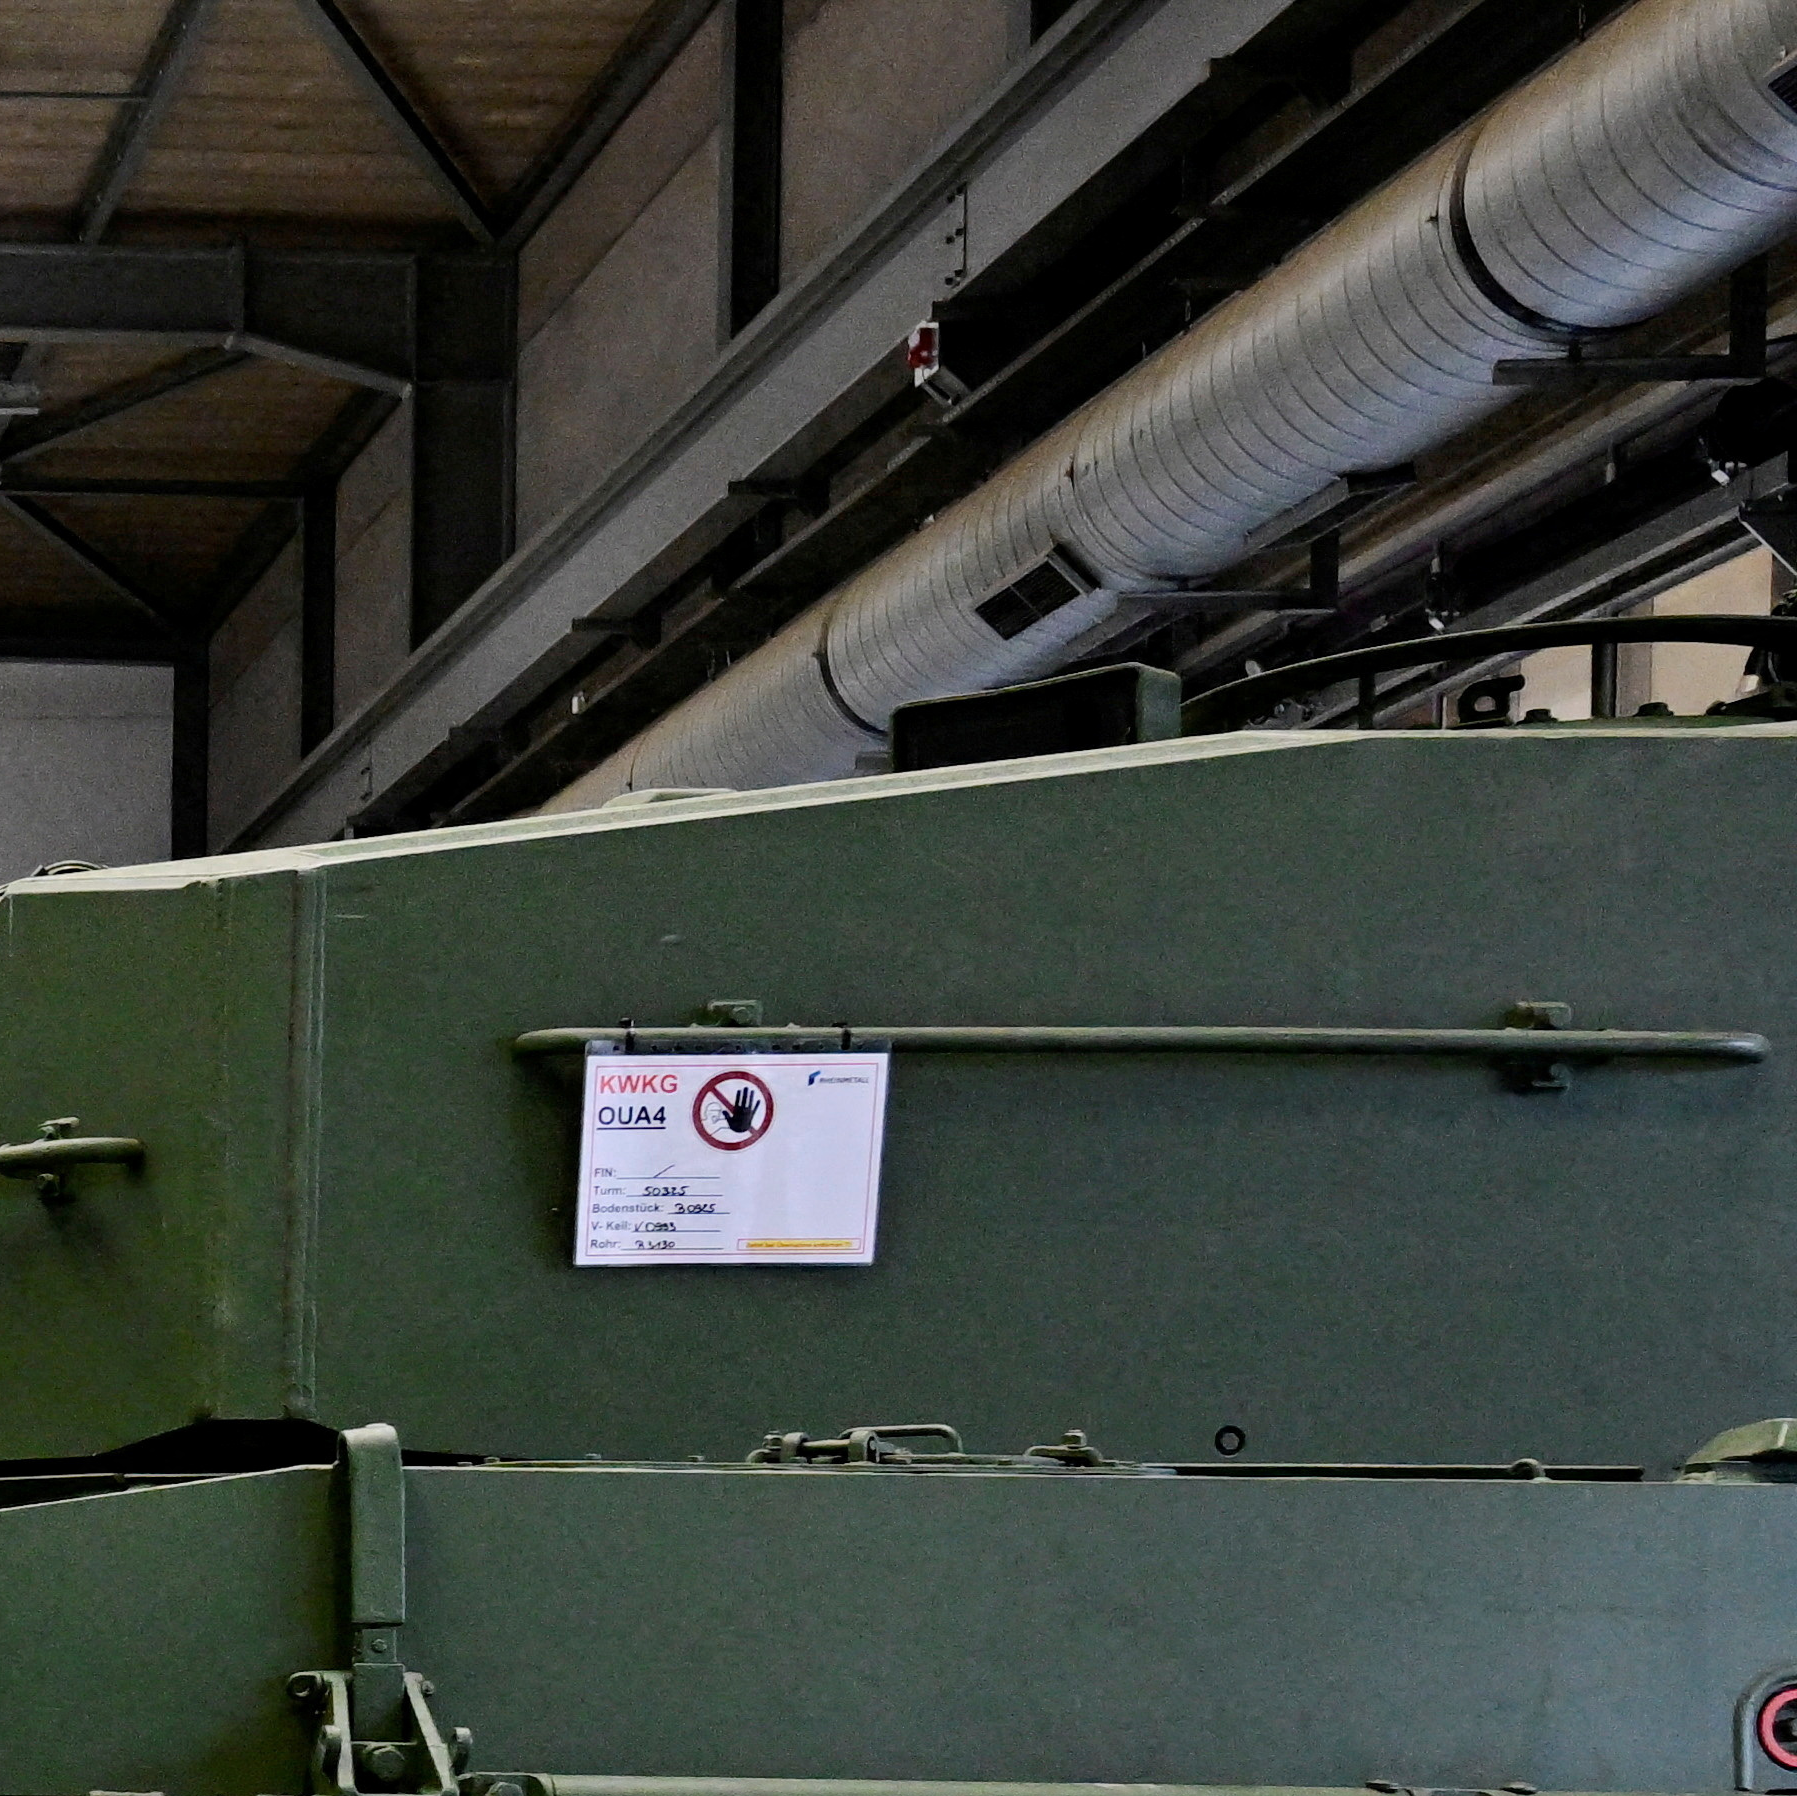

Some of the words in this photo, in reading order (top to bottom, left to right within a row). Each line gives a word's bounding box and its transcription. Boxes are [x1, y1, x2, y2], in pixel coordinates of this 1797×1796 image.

[599, 1073, 678, 1094] KWKG
[598, 1105, 667, 1126] OUA4
[594, 1167, 617, 1178] FIN:
[593, 1185, 626, 1196] Turm:
[592, 1202, 664, 1214] Bodenstück:
